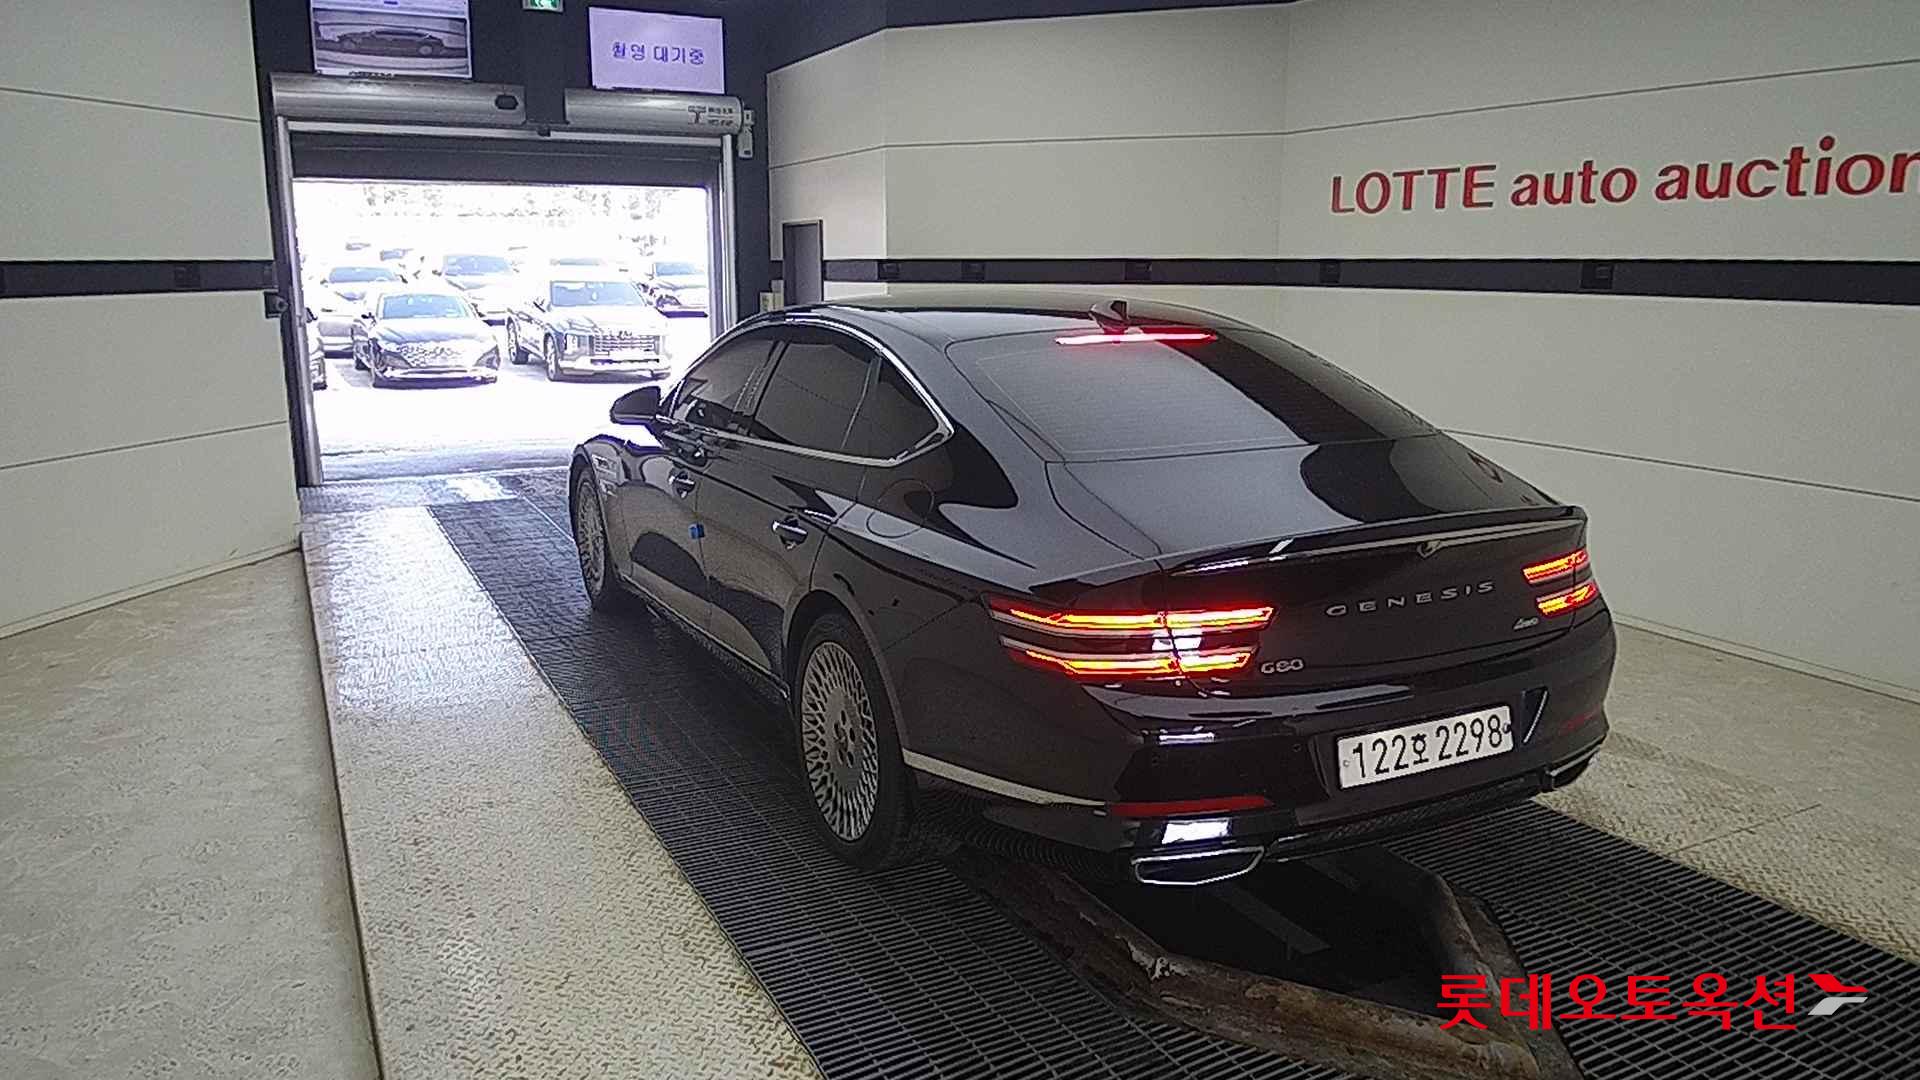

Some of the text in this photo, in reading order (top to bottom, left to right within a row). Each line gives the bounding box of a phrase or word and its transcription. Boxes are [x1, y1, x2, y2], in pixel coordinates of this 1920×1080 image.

[1331, 135, 1920, 215] LOTTE auto auction
[1326, 581, 1494, 616] GENESIS
[1352, 714, 1503, 779] 122호 2298
